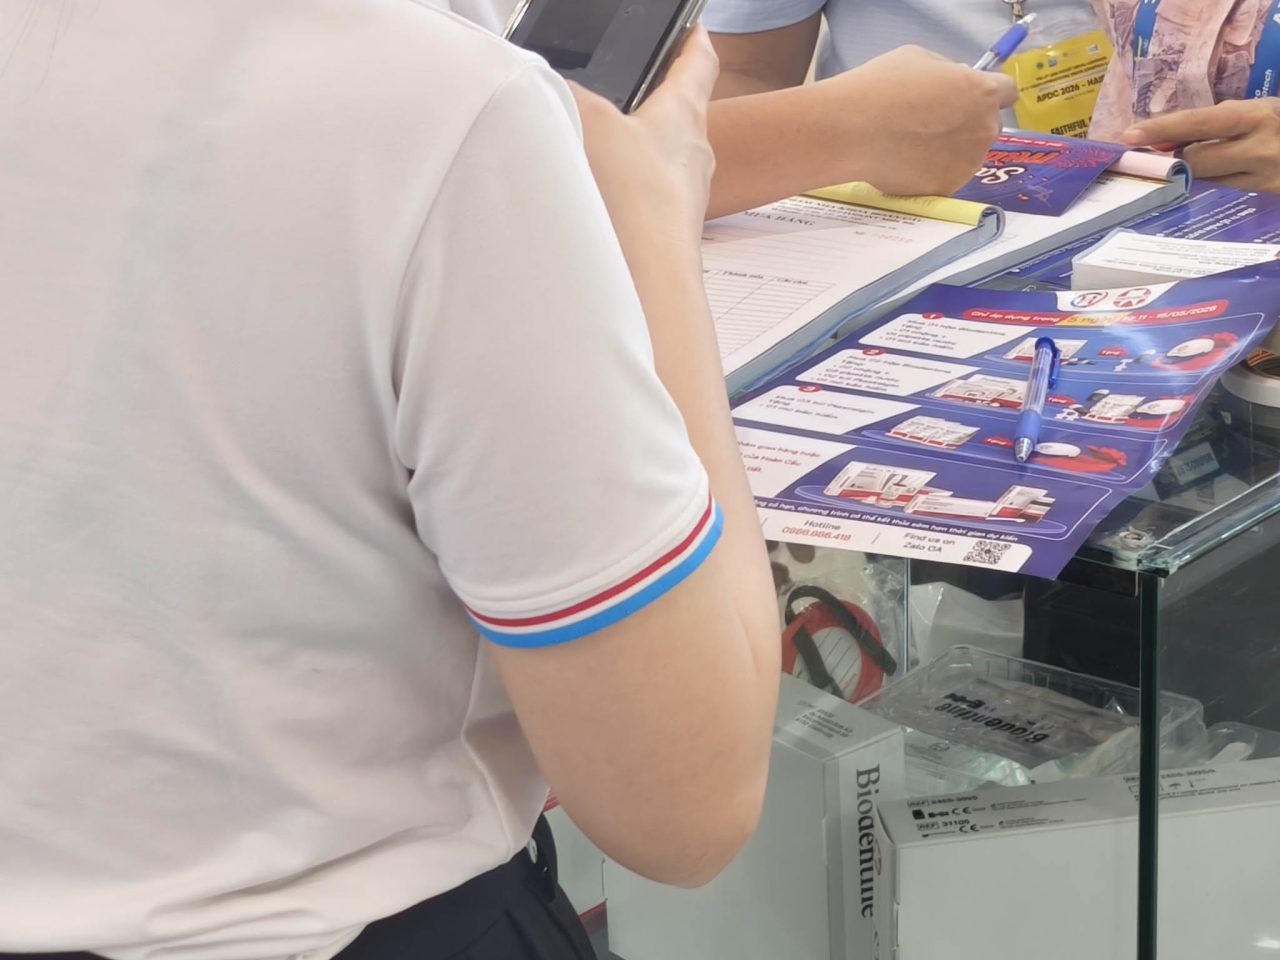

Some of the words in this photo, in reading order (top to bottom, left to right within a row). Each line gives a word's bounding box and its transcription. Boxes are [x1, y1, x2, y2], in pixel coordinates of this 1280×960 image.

[803, 519, 841, 531] Hotline
[903, 532, 927, 541] Find
[903, 541, 925, 551] Zalo
